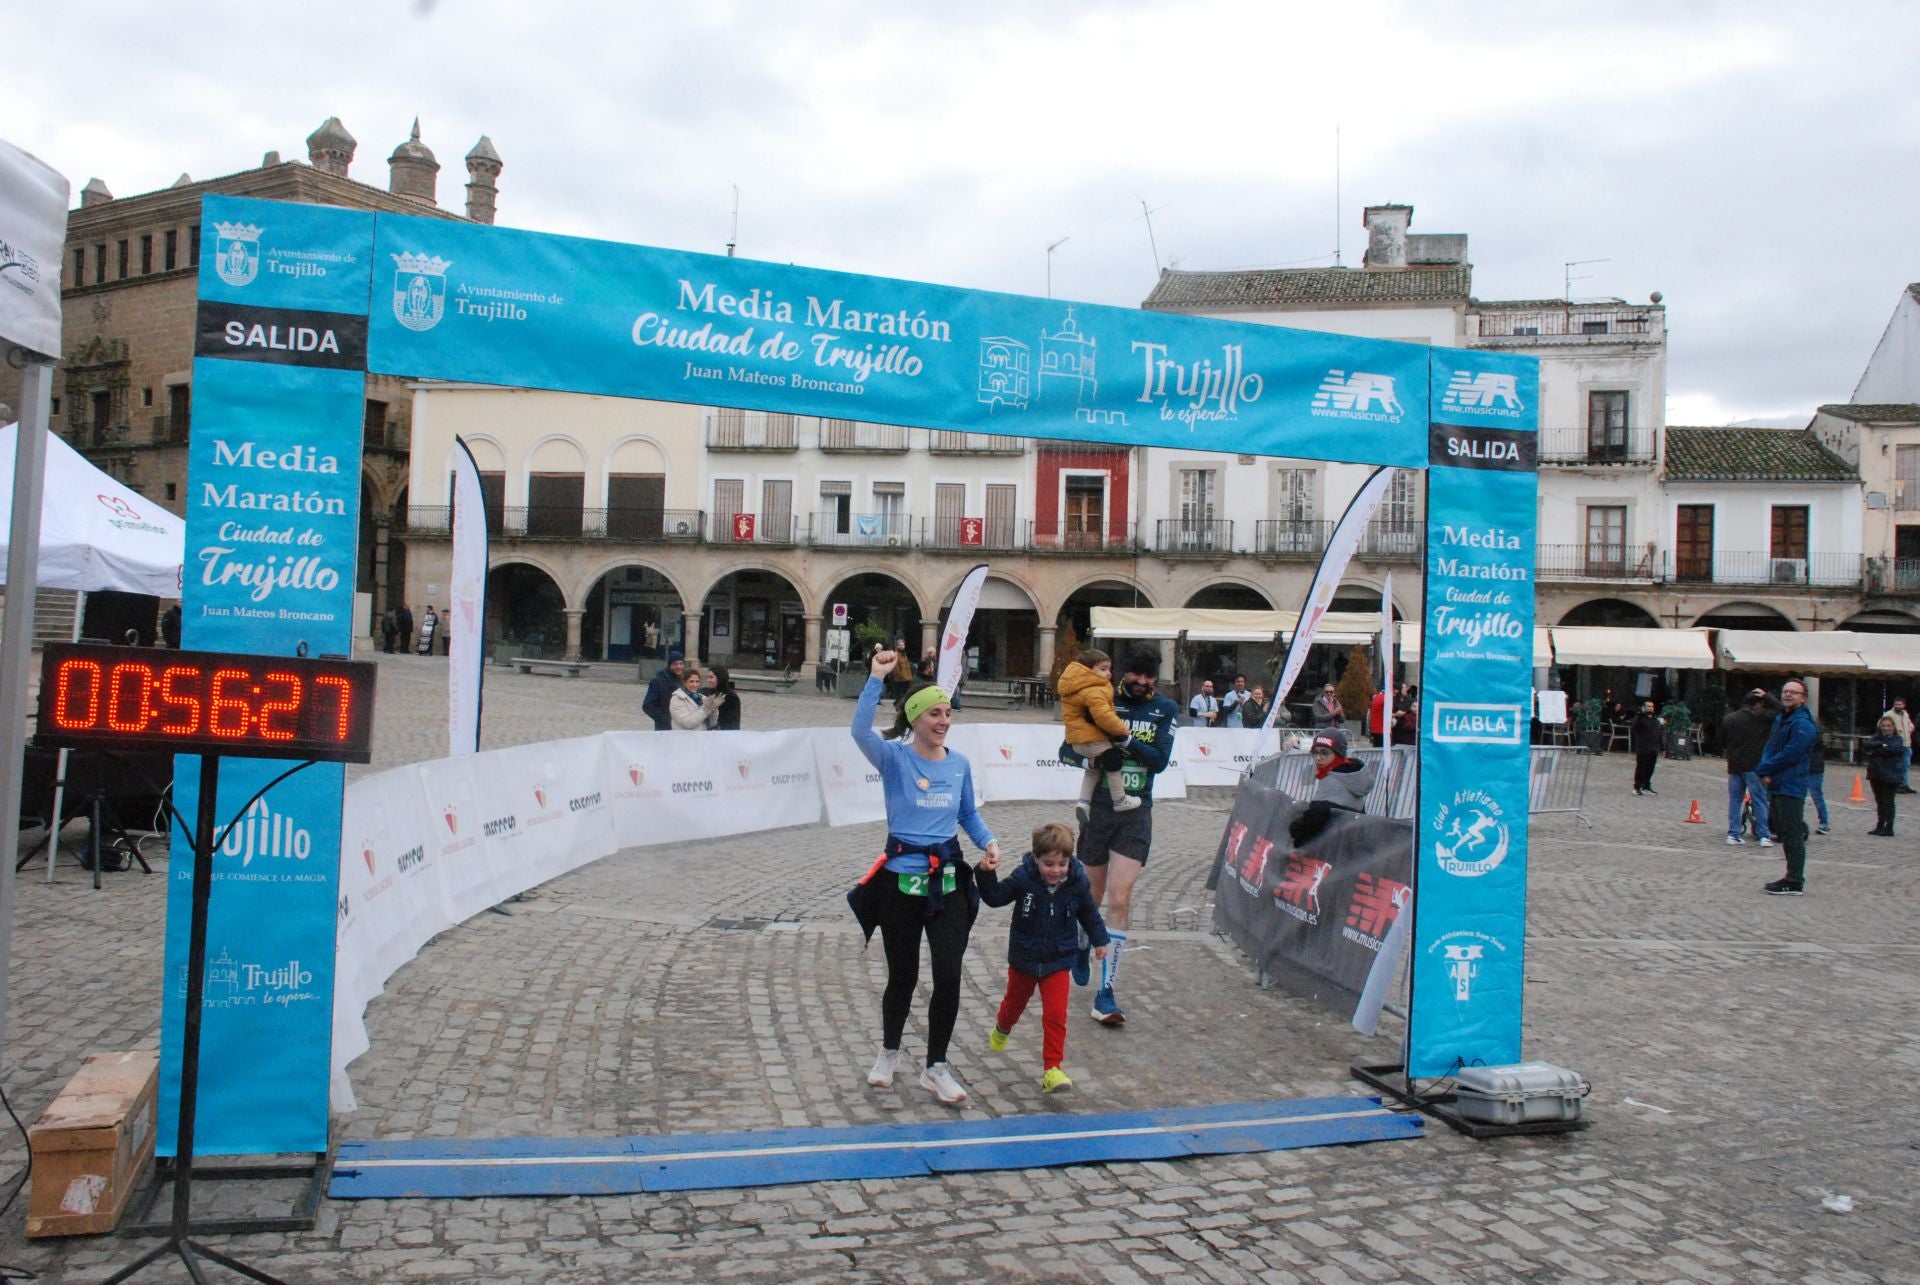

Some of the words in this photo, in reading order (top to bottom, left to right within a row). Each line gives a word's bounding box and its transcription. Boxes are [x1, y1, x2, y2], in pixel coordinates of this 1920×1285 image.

[267, 246, 341, 264] Ayuntamiento
[342, 253, 357, 265] de
[266, 259, 327, 280] Trujillo
[456, 282, 546, 304] Ayuntamiento
[548, 293, 564, 305] de
[455, 298, 528, 323] Trujillo
[676, 279, 793, 324] Media
[804, 296, 952, 343] Maratón
[224, 320, 340, 354] SALIDA
[631, 312, 756, 357] Ciudad
[759, 331, 804, 362] de
[811, 333, 923, 382] Trujillo
[684, 362, 723, 380] Juan
[727, 365, 786, 387] Mateos
[790, 374, 865, 396] Broncano
[1131, 340, 1264, 415] Trujillo
[1160, 399, 1176, 421] te
[1311, 407, 1401, 424] www.musicrun.es
[1441, 403, 1520, 418] www.musicrun.es
[211, 439, 340, 474] Media
[1447, 437, 1520, 461] SALIDA
[201, 482, 347, 516] Maratón
[218, 521, 295, 545] Ciudad
[297, 528, 326, 547] de
[1441, 525, 1522, 550] Media
[198, 546, 340, 602] Trujillo
[1437, 557, 1528, 581] Maratón
[1446, 586, 1492, 605] Ciudad
[1493, 591, 1513, 606] de
[202, 604, 230, 618] Juan
[233, 606, 276, 620] Mateos
[279, 609, 335, 621] Broncano
[1433, 605, 1524, 648] Trujillo
[55, 659, 351, 741] 00:56:27
[1444, 714, 1508, 733] HABLA
[1433, 803, 1449, 831] Club
[1454, 789, 1504, 816] Atletismo
[211, 795, 311, 868] rujillo
[227, 872, 278, 882] COMIENCE
[281, 873, 292, 883] LA
[241, 960, 313, 990] Trujillo
